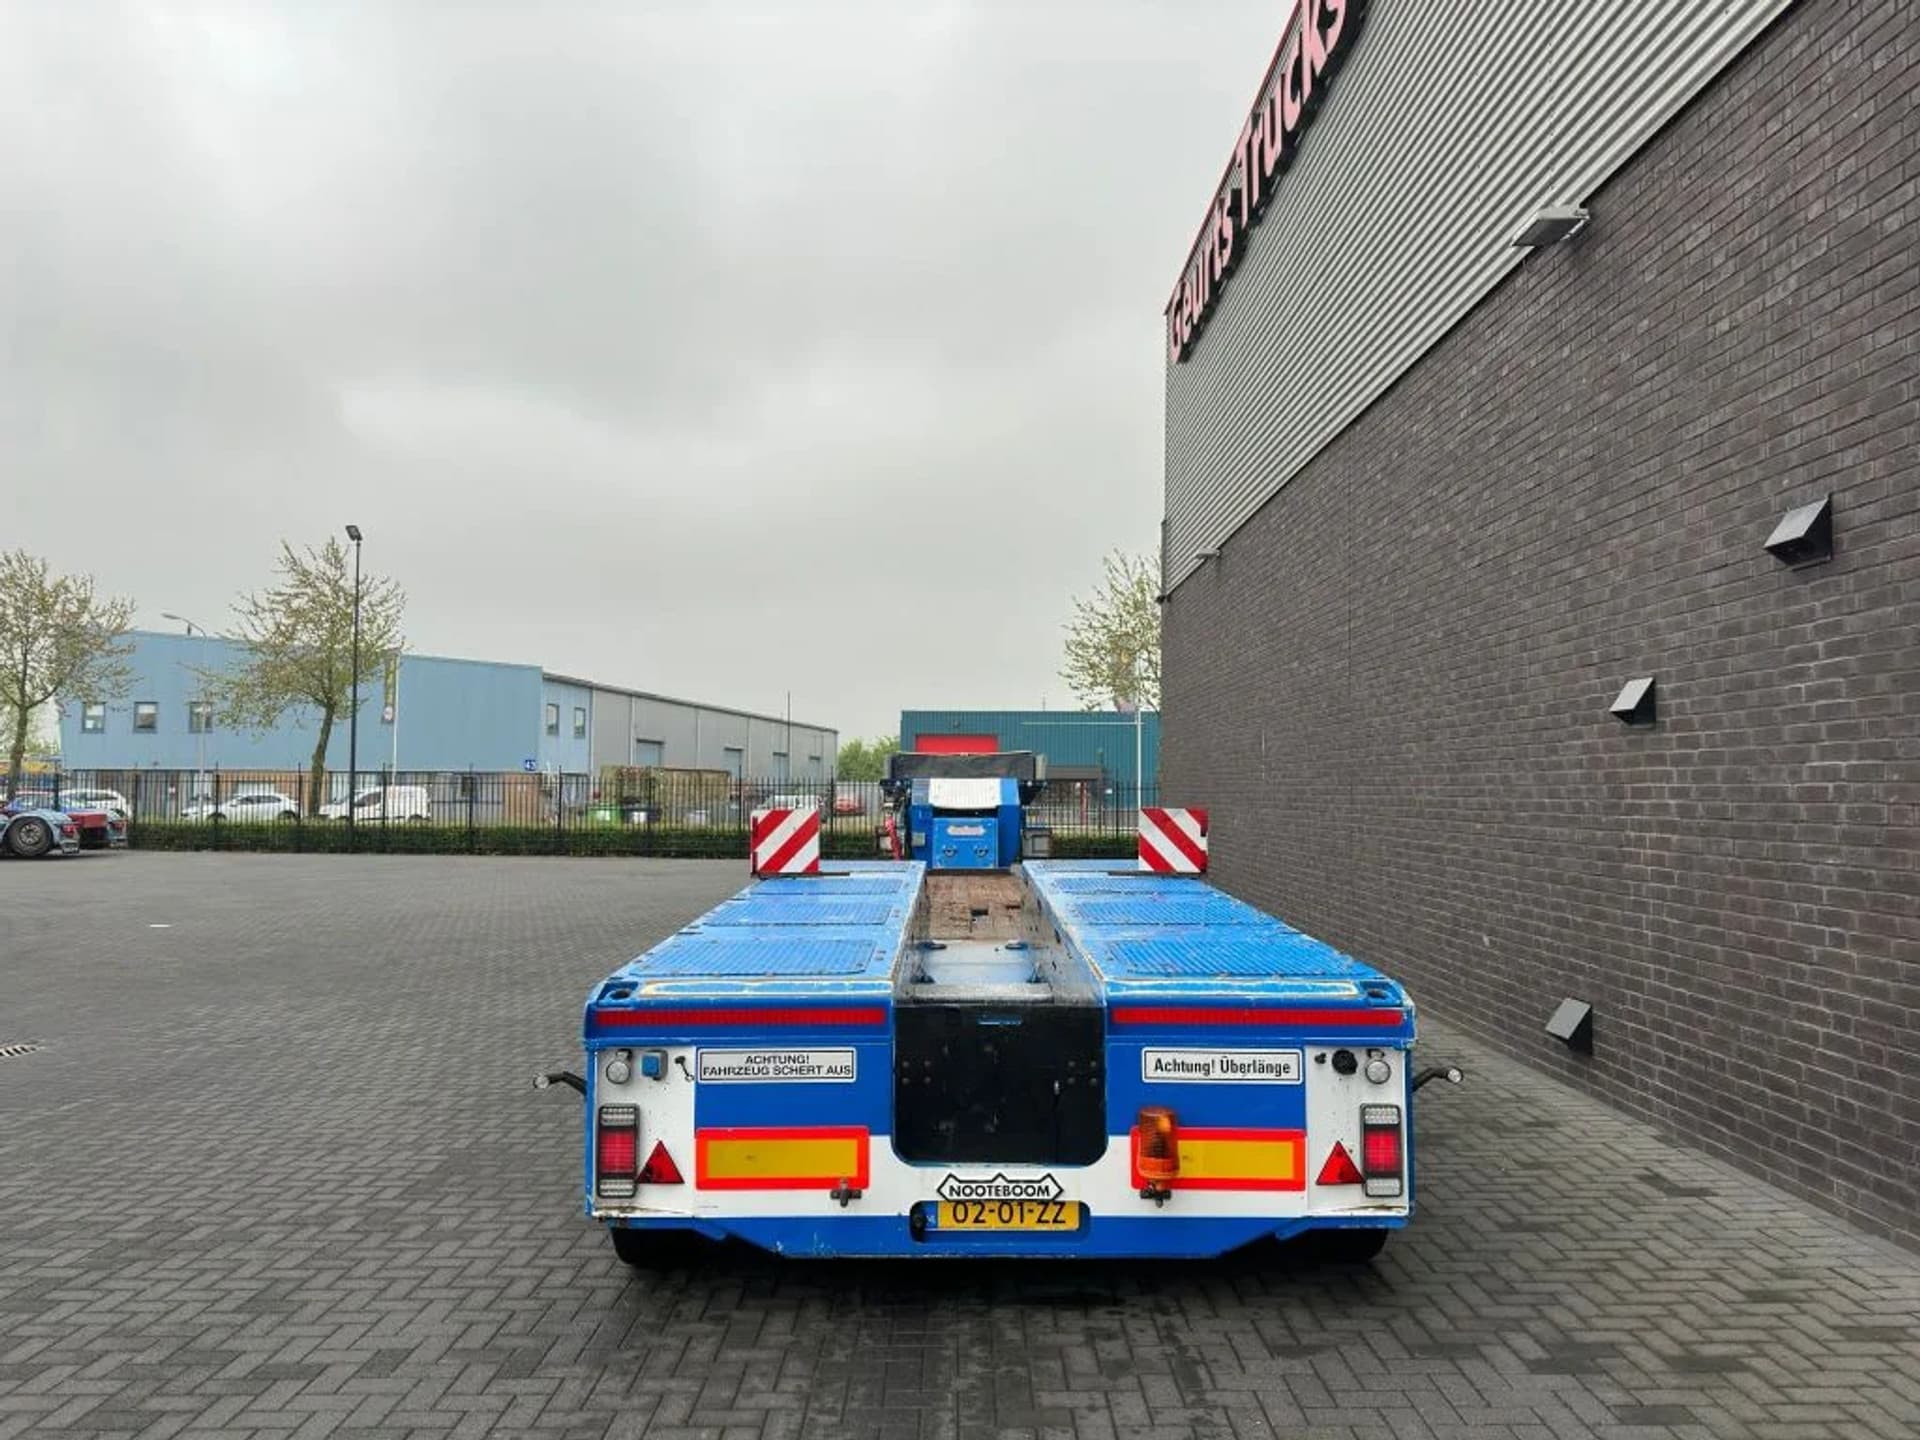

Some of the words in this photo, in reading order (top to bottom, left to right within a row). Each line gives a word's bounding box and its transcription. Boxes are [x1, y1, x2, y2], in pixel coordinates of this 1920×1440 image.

[1171, 192, 1233, 363] Geurts
[1235, 0, 1347, 230] Trucks
[745, 1055, 810, 1065] ACHTUNG!
[1154, 1057, 1215, 1076] Achtung!
[1220, 1056, 1291, 1077] Überlänge
[703, 1066, 770, 1076] FAHRZEUG
[773, 1065, 823, 1075] SCHERT
[826, 1065, 851, 1075] AUS
[950, 1185, 1050, 1197] NOOTEBOOM
[952, 1201, 1066, 1224] 02-01-ZZ
